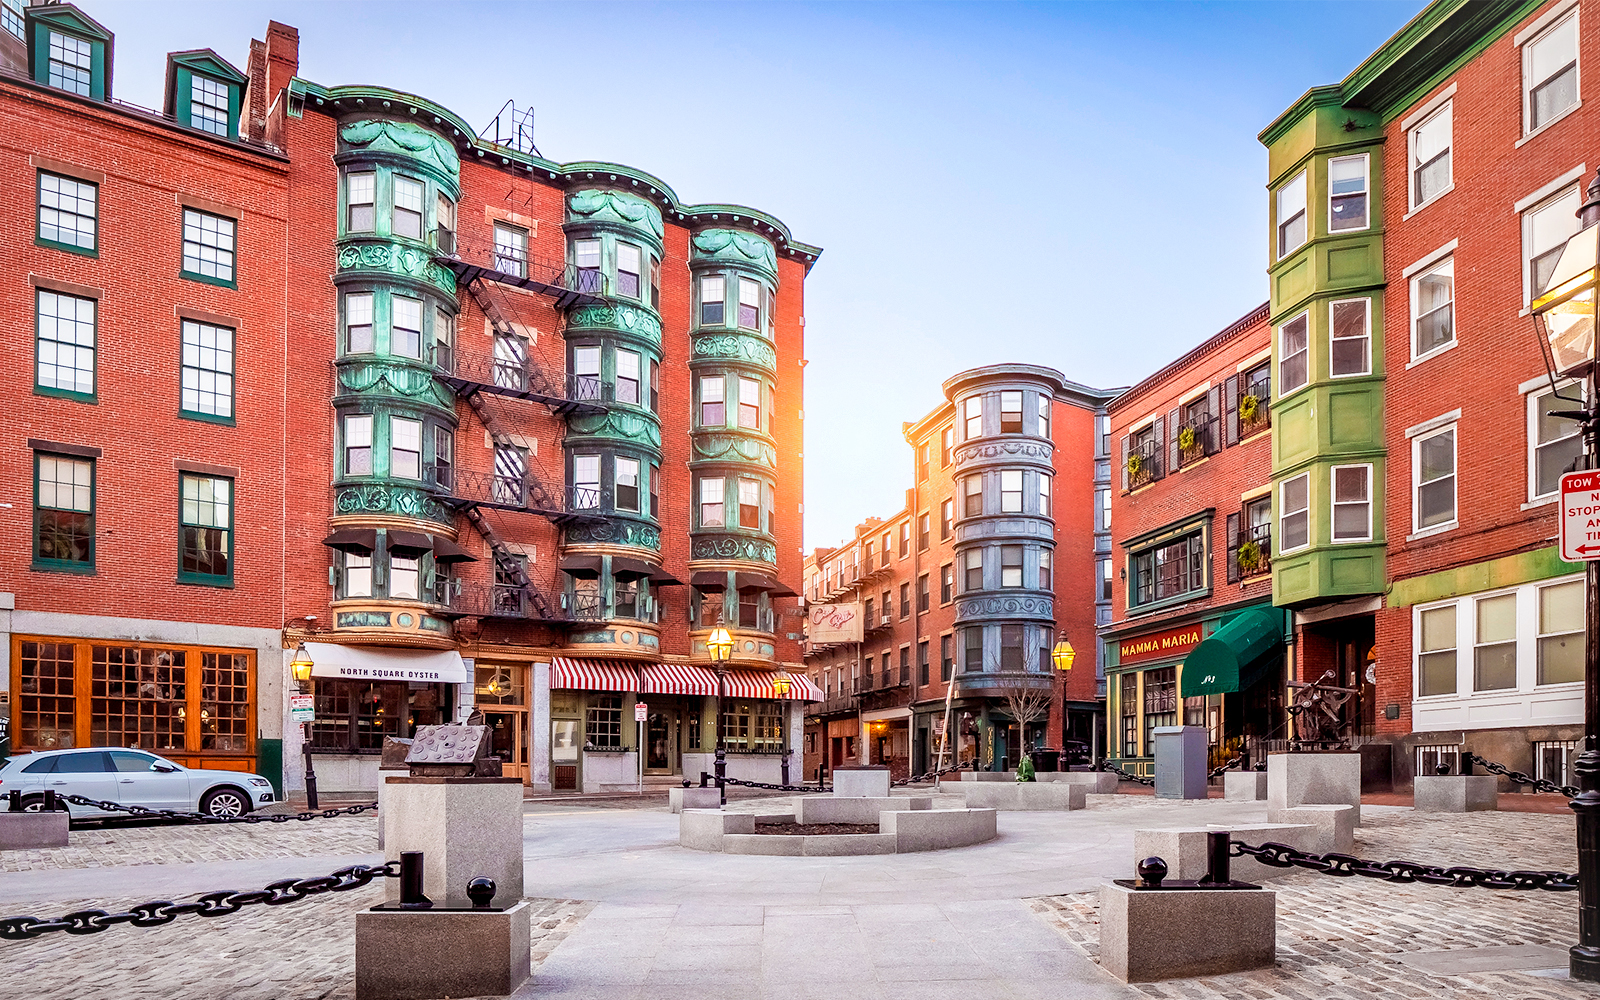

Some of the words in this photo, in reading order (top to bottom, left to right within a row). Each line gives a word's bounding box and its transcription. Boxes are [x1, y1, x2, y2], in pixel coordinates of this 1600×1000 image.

[1567, 478, 1592, 489] TOW
[1585, 531, 1600, 541] TI
[1122, 640, 1159, 656] MAMMA
[1162, 632, 1199, 648] MARIA
[372, 669, 404, 678] SQUARE
[408, 671, 439, 679] OYSTER
